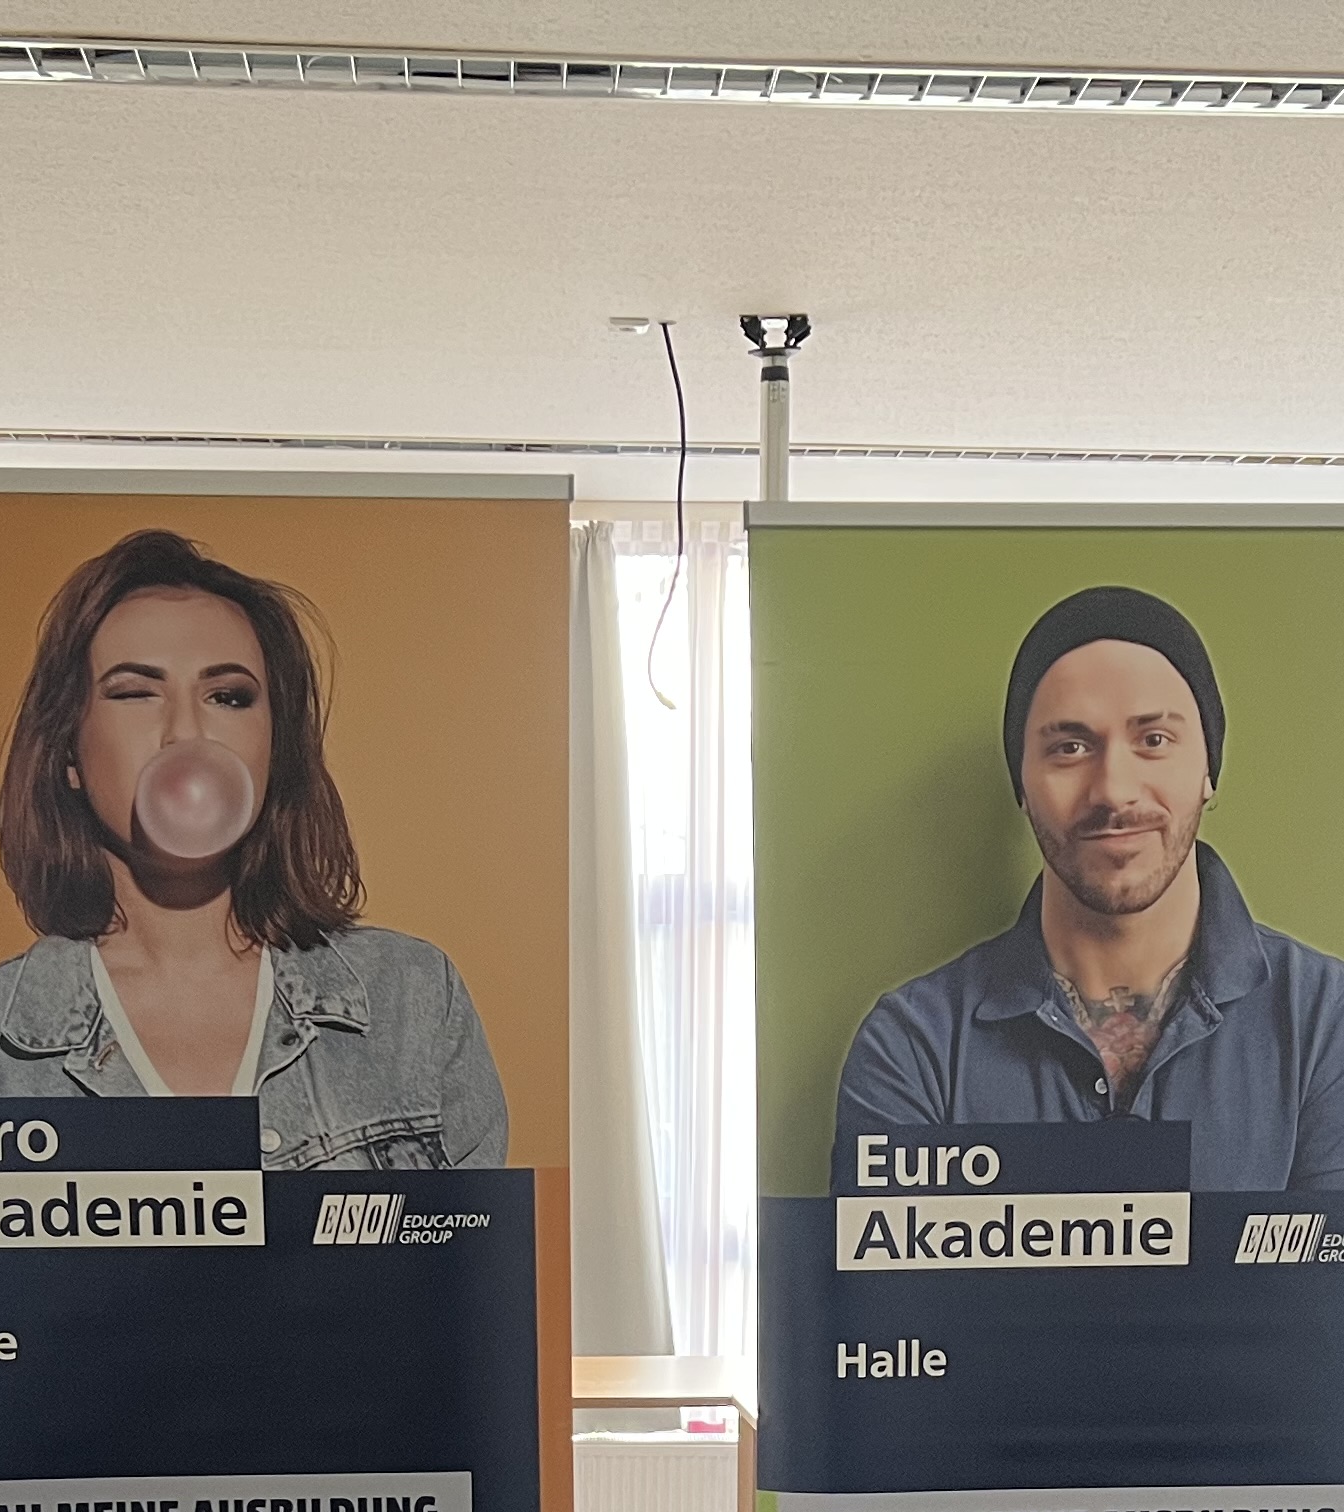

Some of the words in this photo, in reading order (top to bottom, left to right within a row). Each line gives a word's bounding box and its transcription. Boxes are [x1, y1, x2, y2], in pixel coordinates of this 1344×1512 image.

[856, 1133, 1001, 1188] Euro
[398, 1230, 454, 1245] GROUP
[402, 1213, 491, 1229] EDUCATION
[854, 1203, 1173, 1261] Akademie
[836, 1339, 947, 1379] Halle
